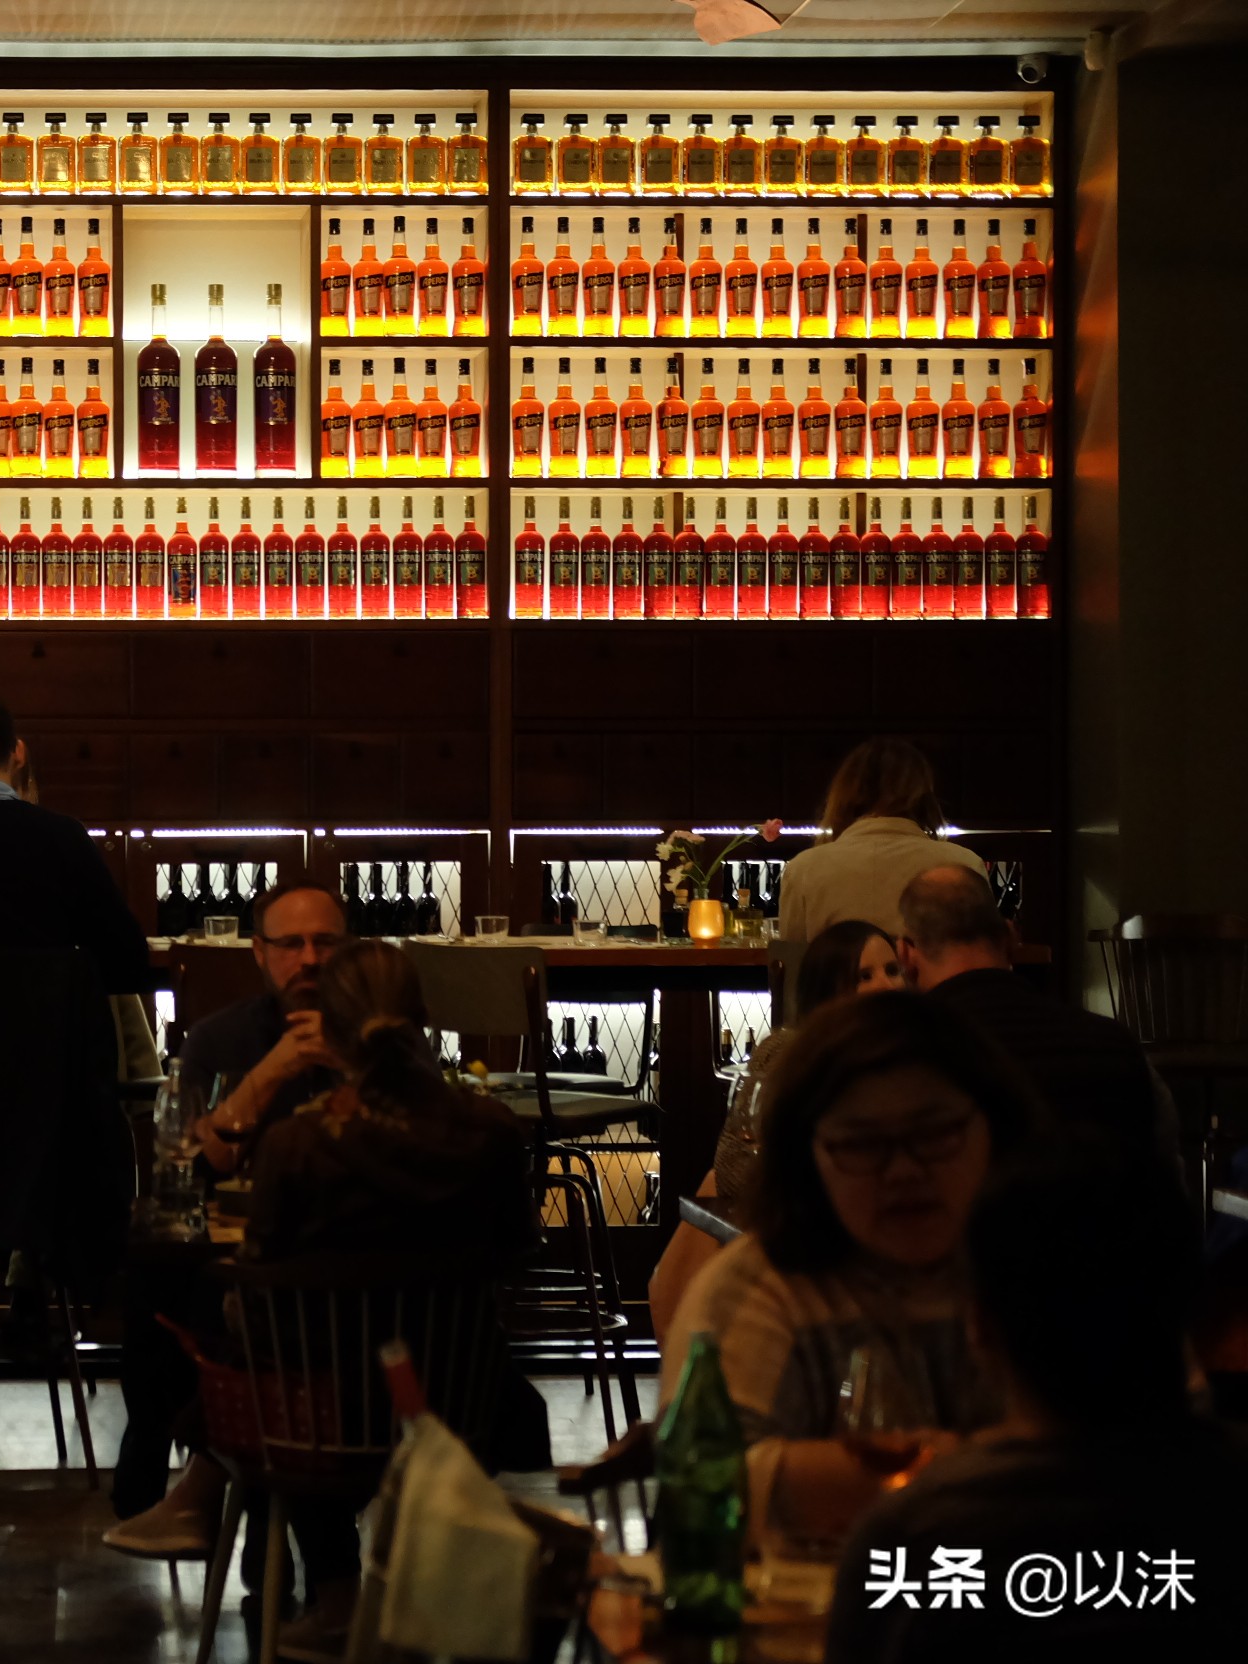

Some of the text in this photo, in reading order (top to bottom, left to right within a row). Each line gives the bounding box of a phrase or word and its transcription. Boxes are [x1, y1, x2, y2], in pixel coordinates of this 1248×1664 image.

[140, 374, 180, 388] CAMPAR
[196, 374, 237, 386] CAMPAR
[256, 374, 296, 388] CAMPAR
